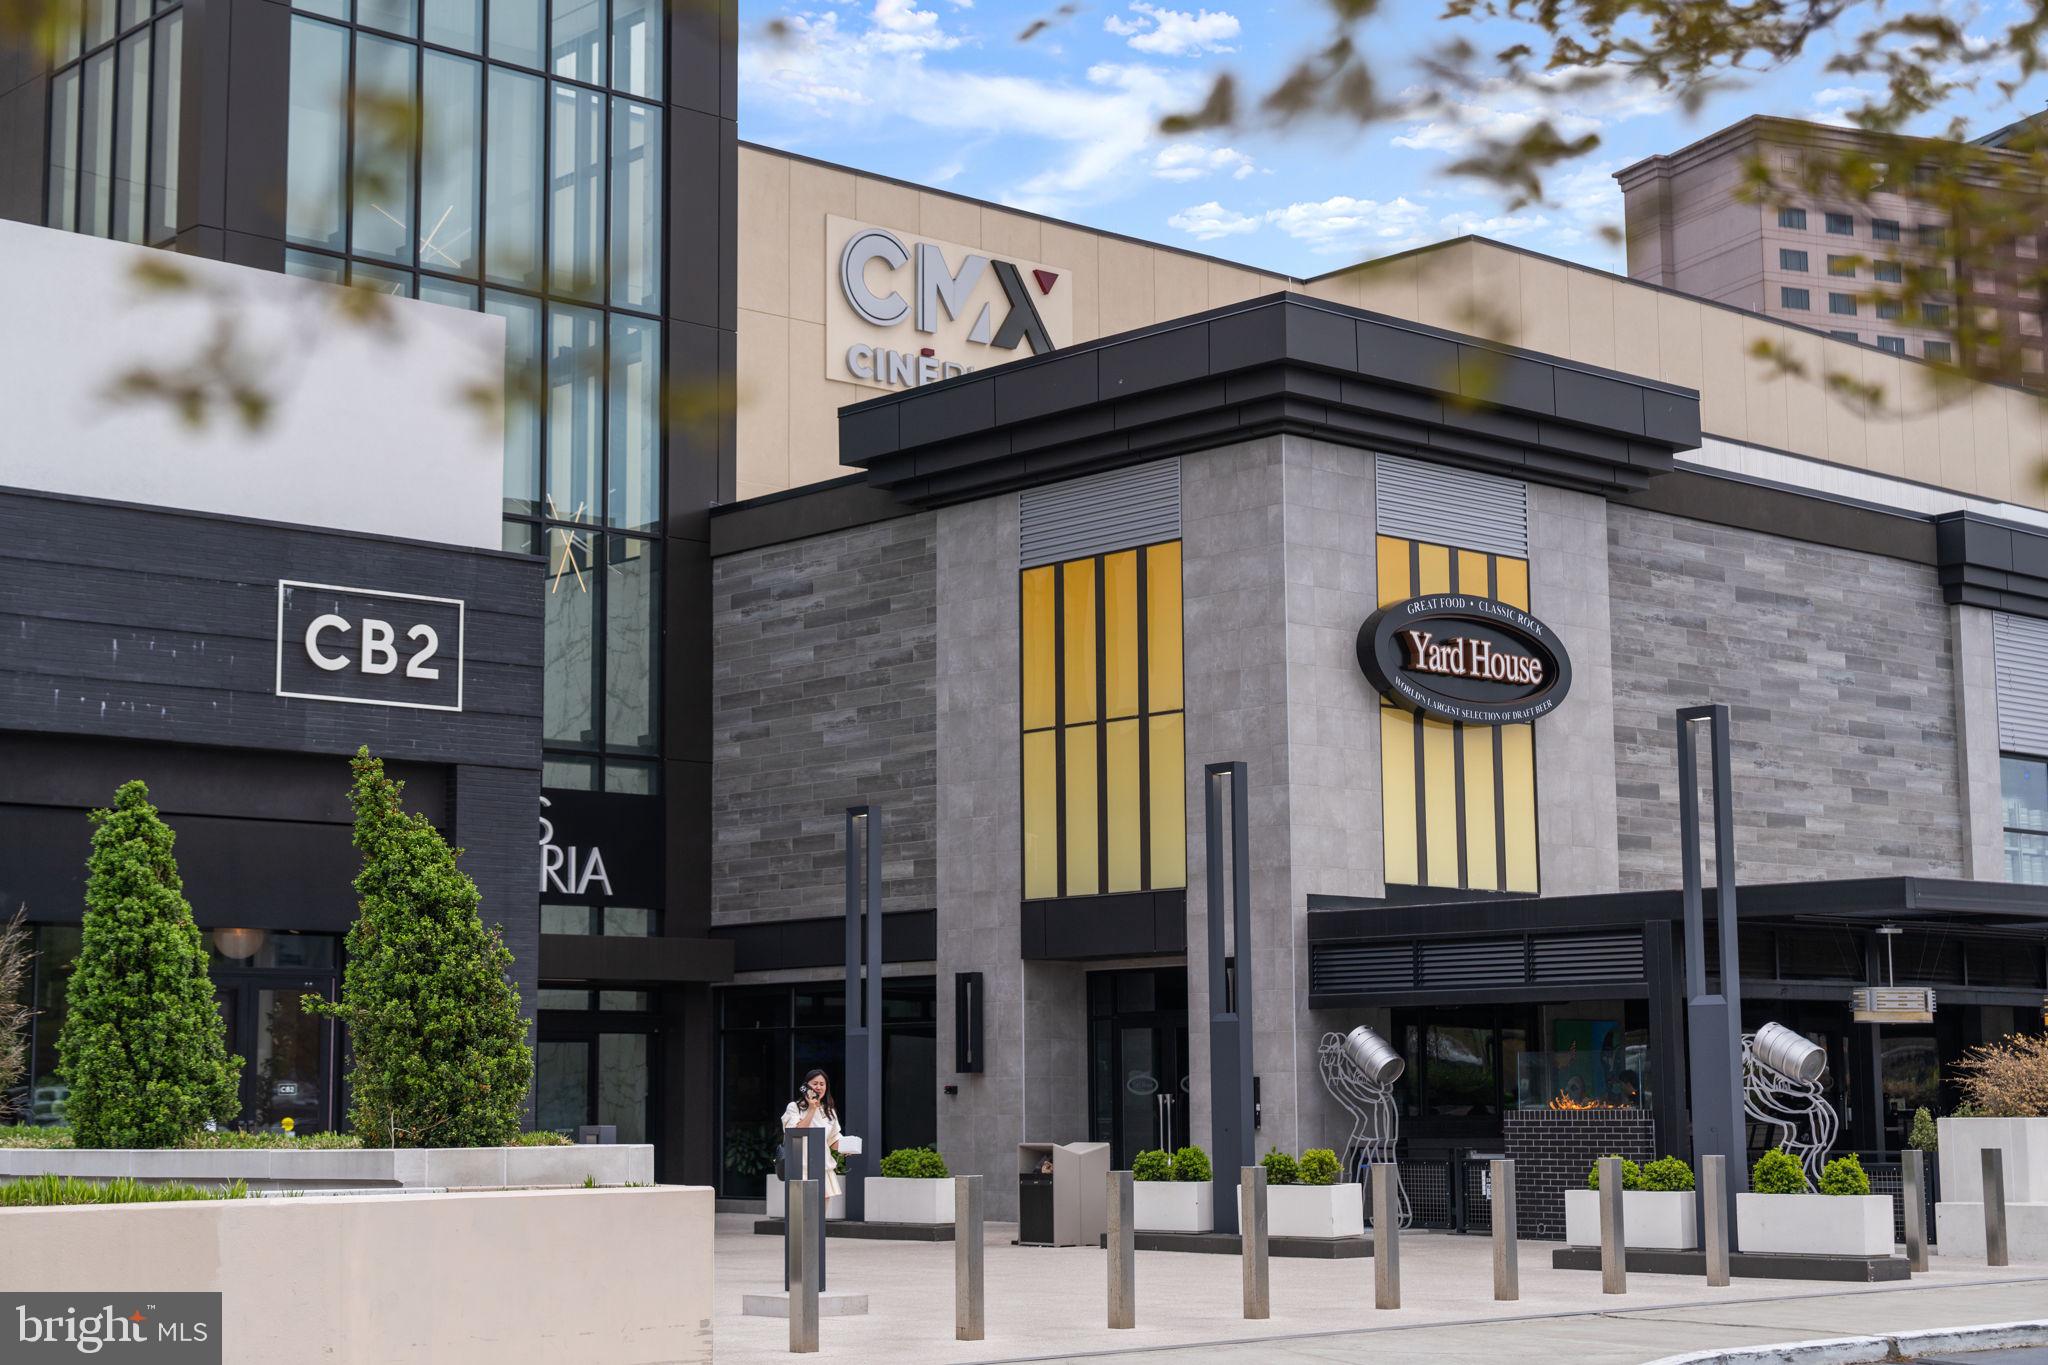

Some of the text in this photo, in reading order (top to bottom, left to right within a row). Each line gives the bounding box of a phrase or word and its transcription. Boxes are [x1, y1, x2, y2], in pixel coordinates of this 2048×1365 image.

[839, 228, 1059, 355] CMX
[1407, 598, 1543, 636] GREAT FOOD CLASSIC ROCK
[305, 614, 439, 680] CB2
[1409, 630, 1544, 685] Yard House
[1395, 675, 1553, 721] WORLD'S LARGEST SELECTION OF DRAFT BEER
